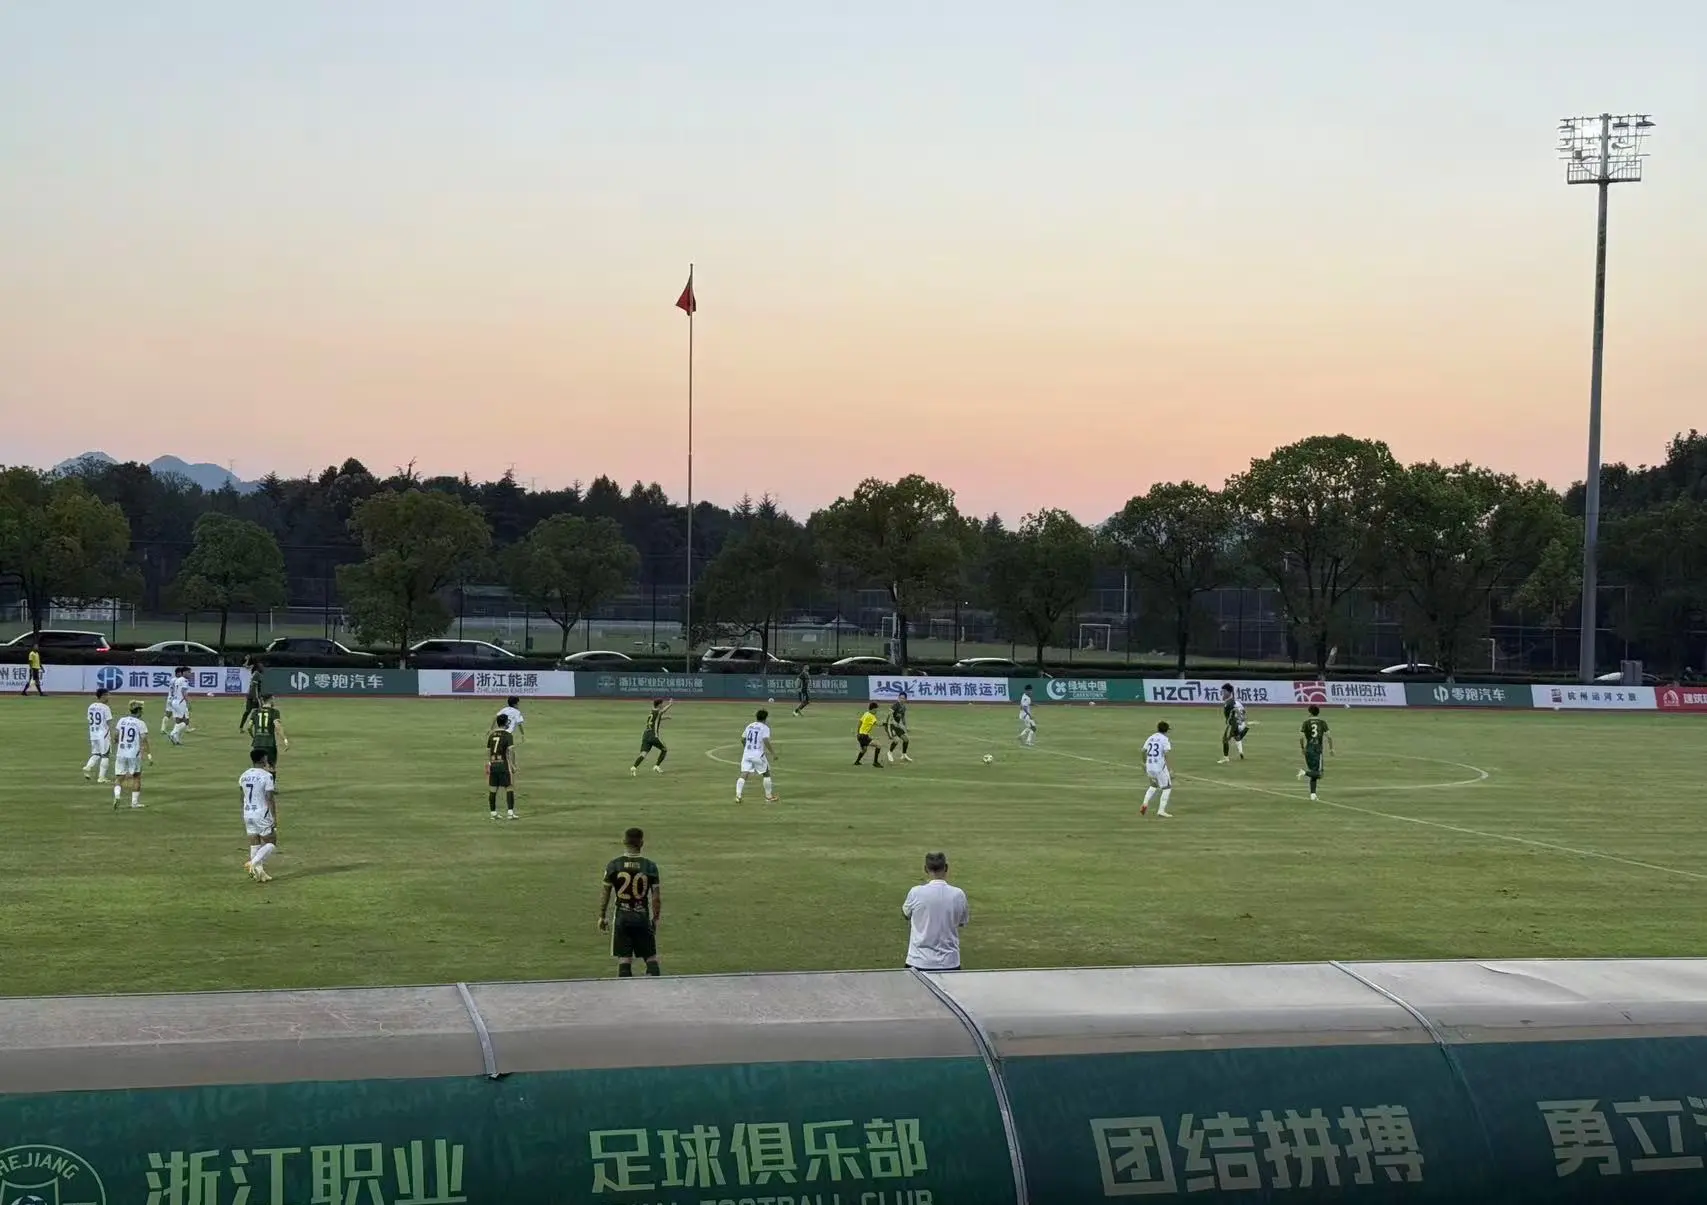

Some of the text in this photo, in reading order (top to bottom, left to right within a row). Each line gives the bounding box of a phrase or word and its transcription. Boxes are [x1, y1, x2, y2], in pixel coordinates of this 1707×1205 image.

[314, 673, 383, 689] 零跑汽车
[476, 672, 539, 688] 浙江能源
[918, 681, 1007, 697] 杭州商旅运河
[1153, 686, 1198, 701] HZCT
[1204, 686, 1269, 702] 杭城投
[1451, 687, 1505, 701] 零跑汽车
[88, 711, 102, 726] 39
[257, 711, 269, 728] 11
[120, 726, 136, 743] 19
[747, 730, 759, 745] 41
[1310, 723, 1318, 738] 3
[492, 736, 500, 754] 7
[1147, 742, 1160, 758] 23
[246, 783, 254, 804] 7
[617, 871, 649, 900] 20
[1536, 1096, 1707, 1177] 勇立
[590, 1118, 928, 1193] 足球俱乐部
[1089, 1103, 1426, 1197] 团结拼搏
[145, 1138, 468, 1205] 浙江职业
